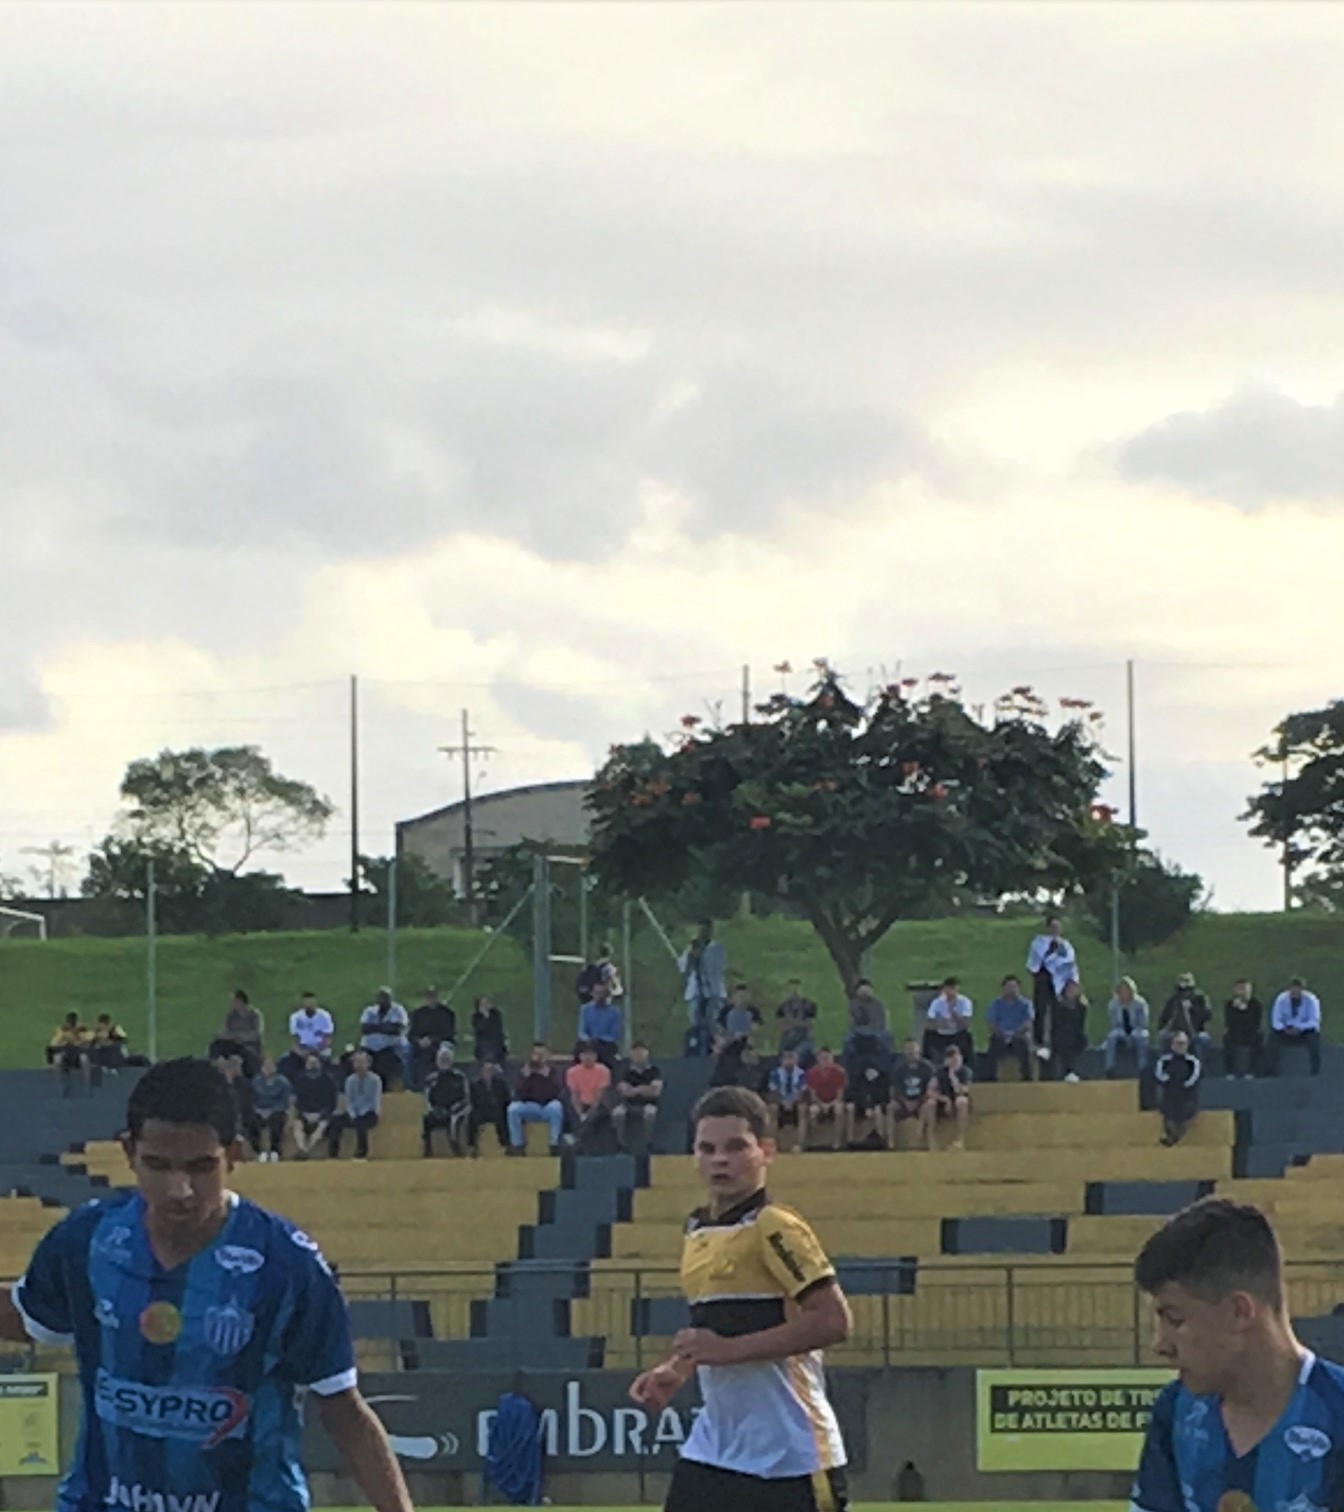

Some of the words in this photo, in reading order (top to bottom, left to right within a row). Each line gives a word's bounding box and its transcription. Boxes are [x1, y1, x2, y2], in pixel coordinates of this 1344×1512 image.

[1008, 1390, 1097, 1406] PROJETO
[1101, 1390, 1125, 1406] DE
[993, 1412, 1019, 1429] DE
[1022, 1412, 1103, 1429] ATLETAS
[1107, 1411, 1132, 1428] DE
